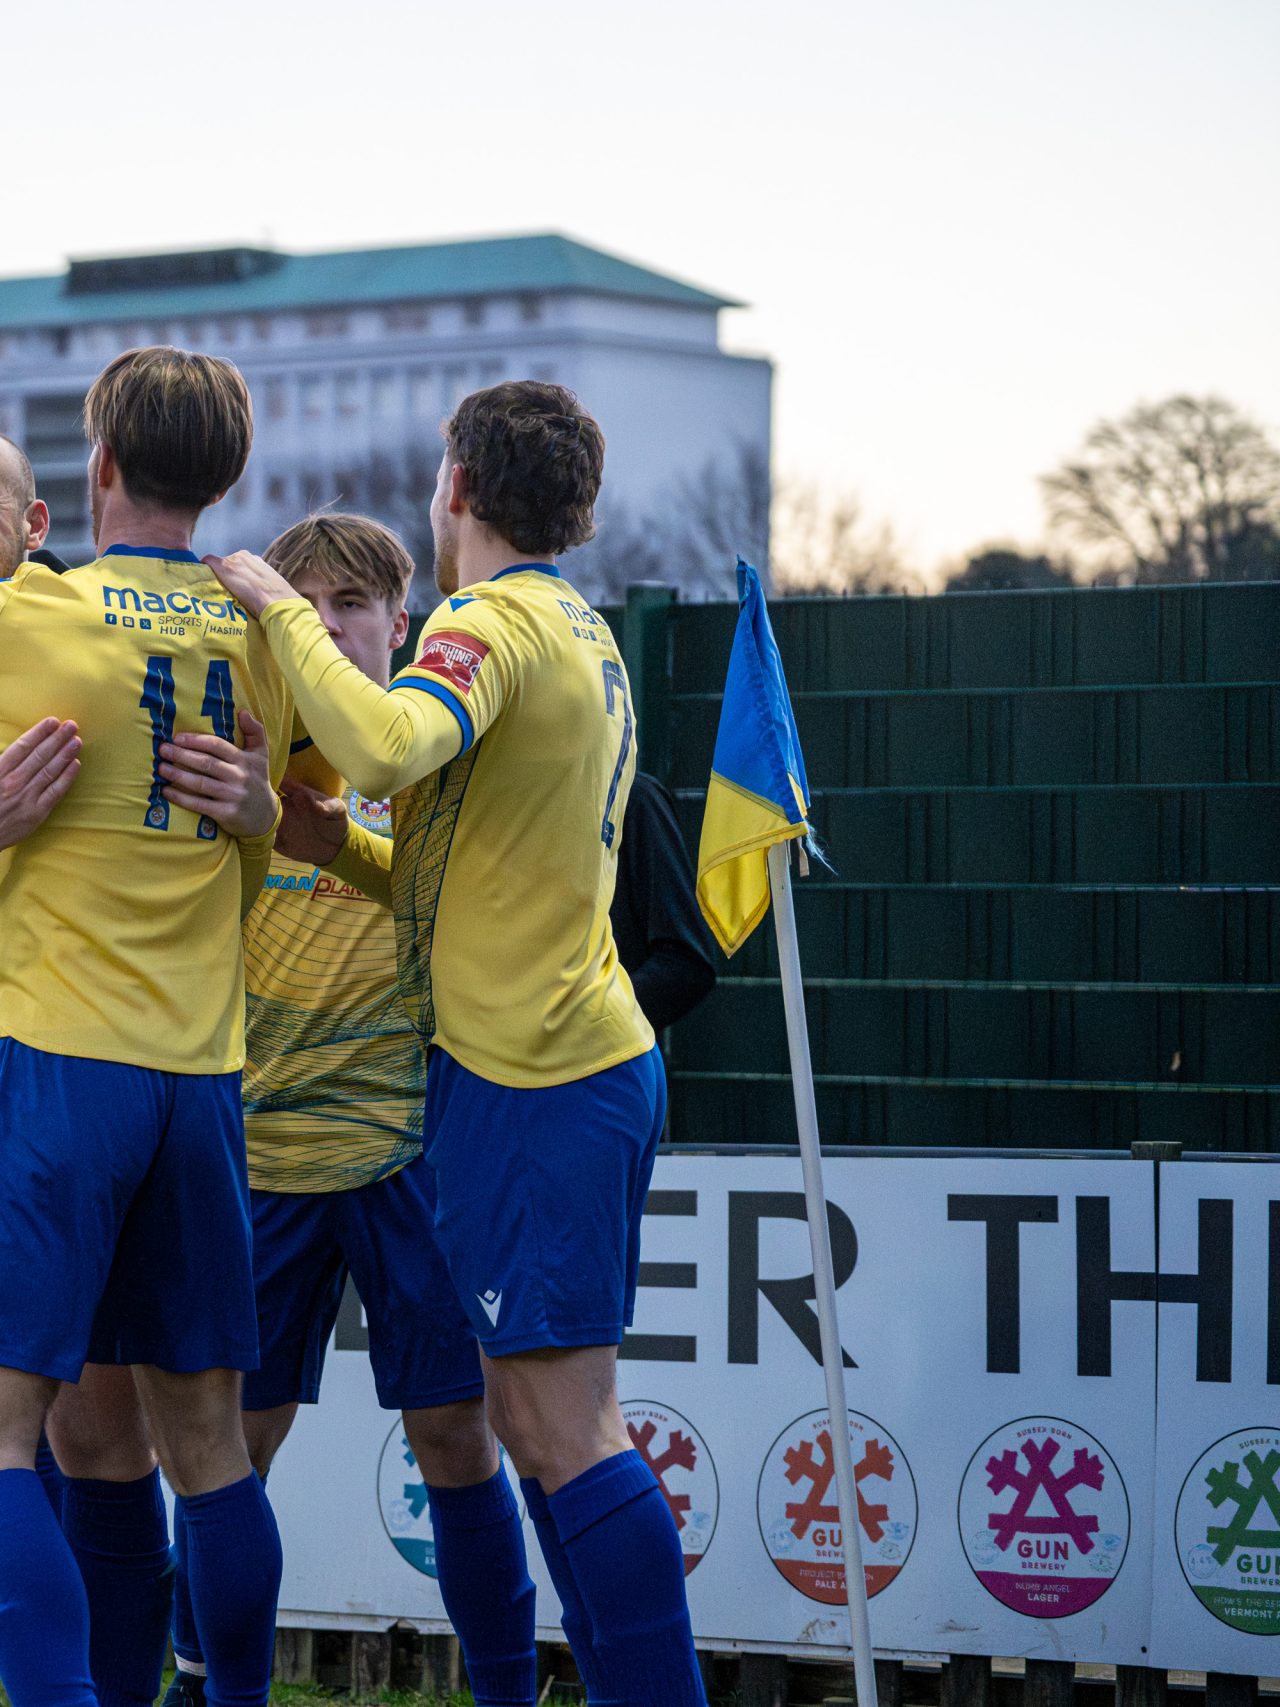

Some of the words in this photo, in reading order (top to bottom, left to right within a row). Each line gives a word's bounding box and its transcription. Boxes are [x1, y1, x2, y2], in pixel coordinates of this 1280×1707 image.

[556, 599, 608, 627] mac
[158, 615, 202, 627] SPORTS
[160, 626, 186, 636] HUB
[138, 655, 236, 841] 11
[263, 868, 320, 891] MAN
[310, 877, 362, 901] PLAN
[812, 1528, 843, 1547] GU
[1017, 1539, 1069, 1560] GUN
[1021, 1561, 1066, 1571] BREWERY
[815, 1579, 837, 1589] PALE
[1027, 1593, 1060, 1603] LAGER
[1224, 1607, 1273, 1619] VERMONT
